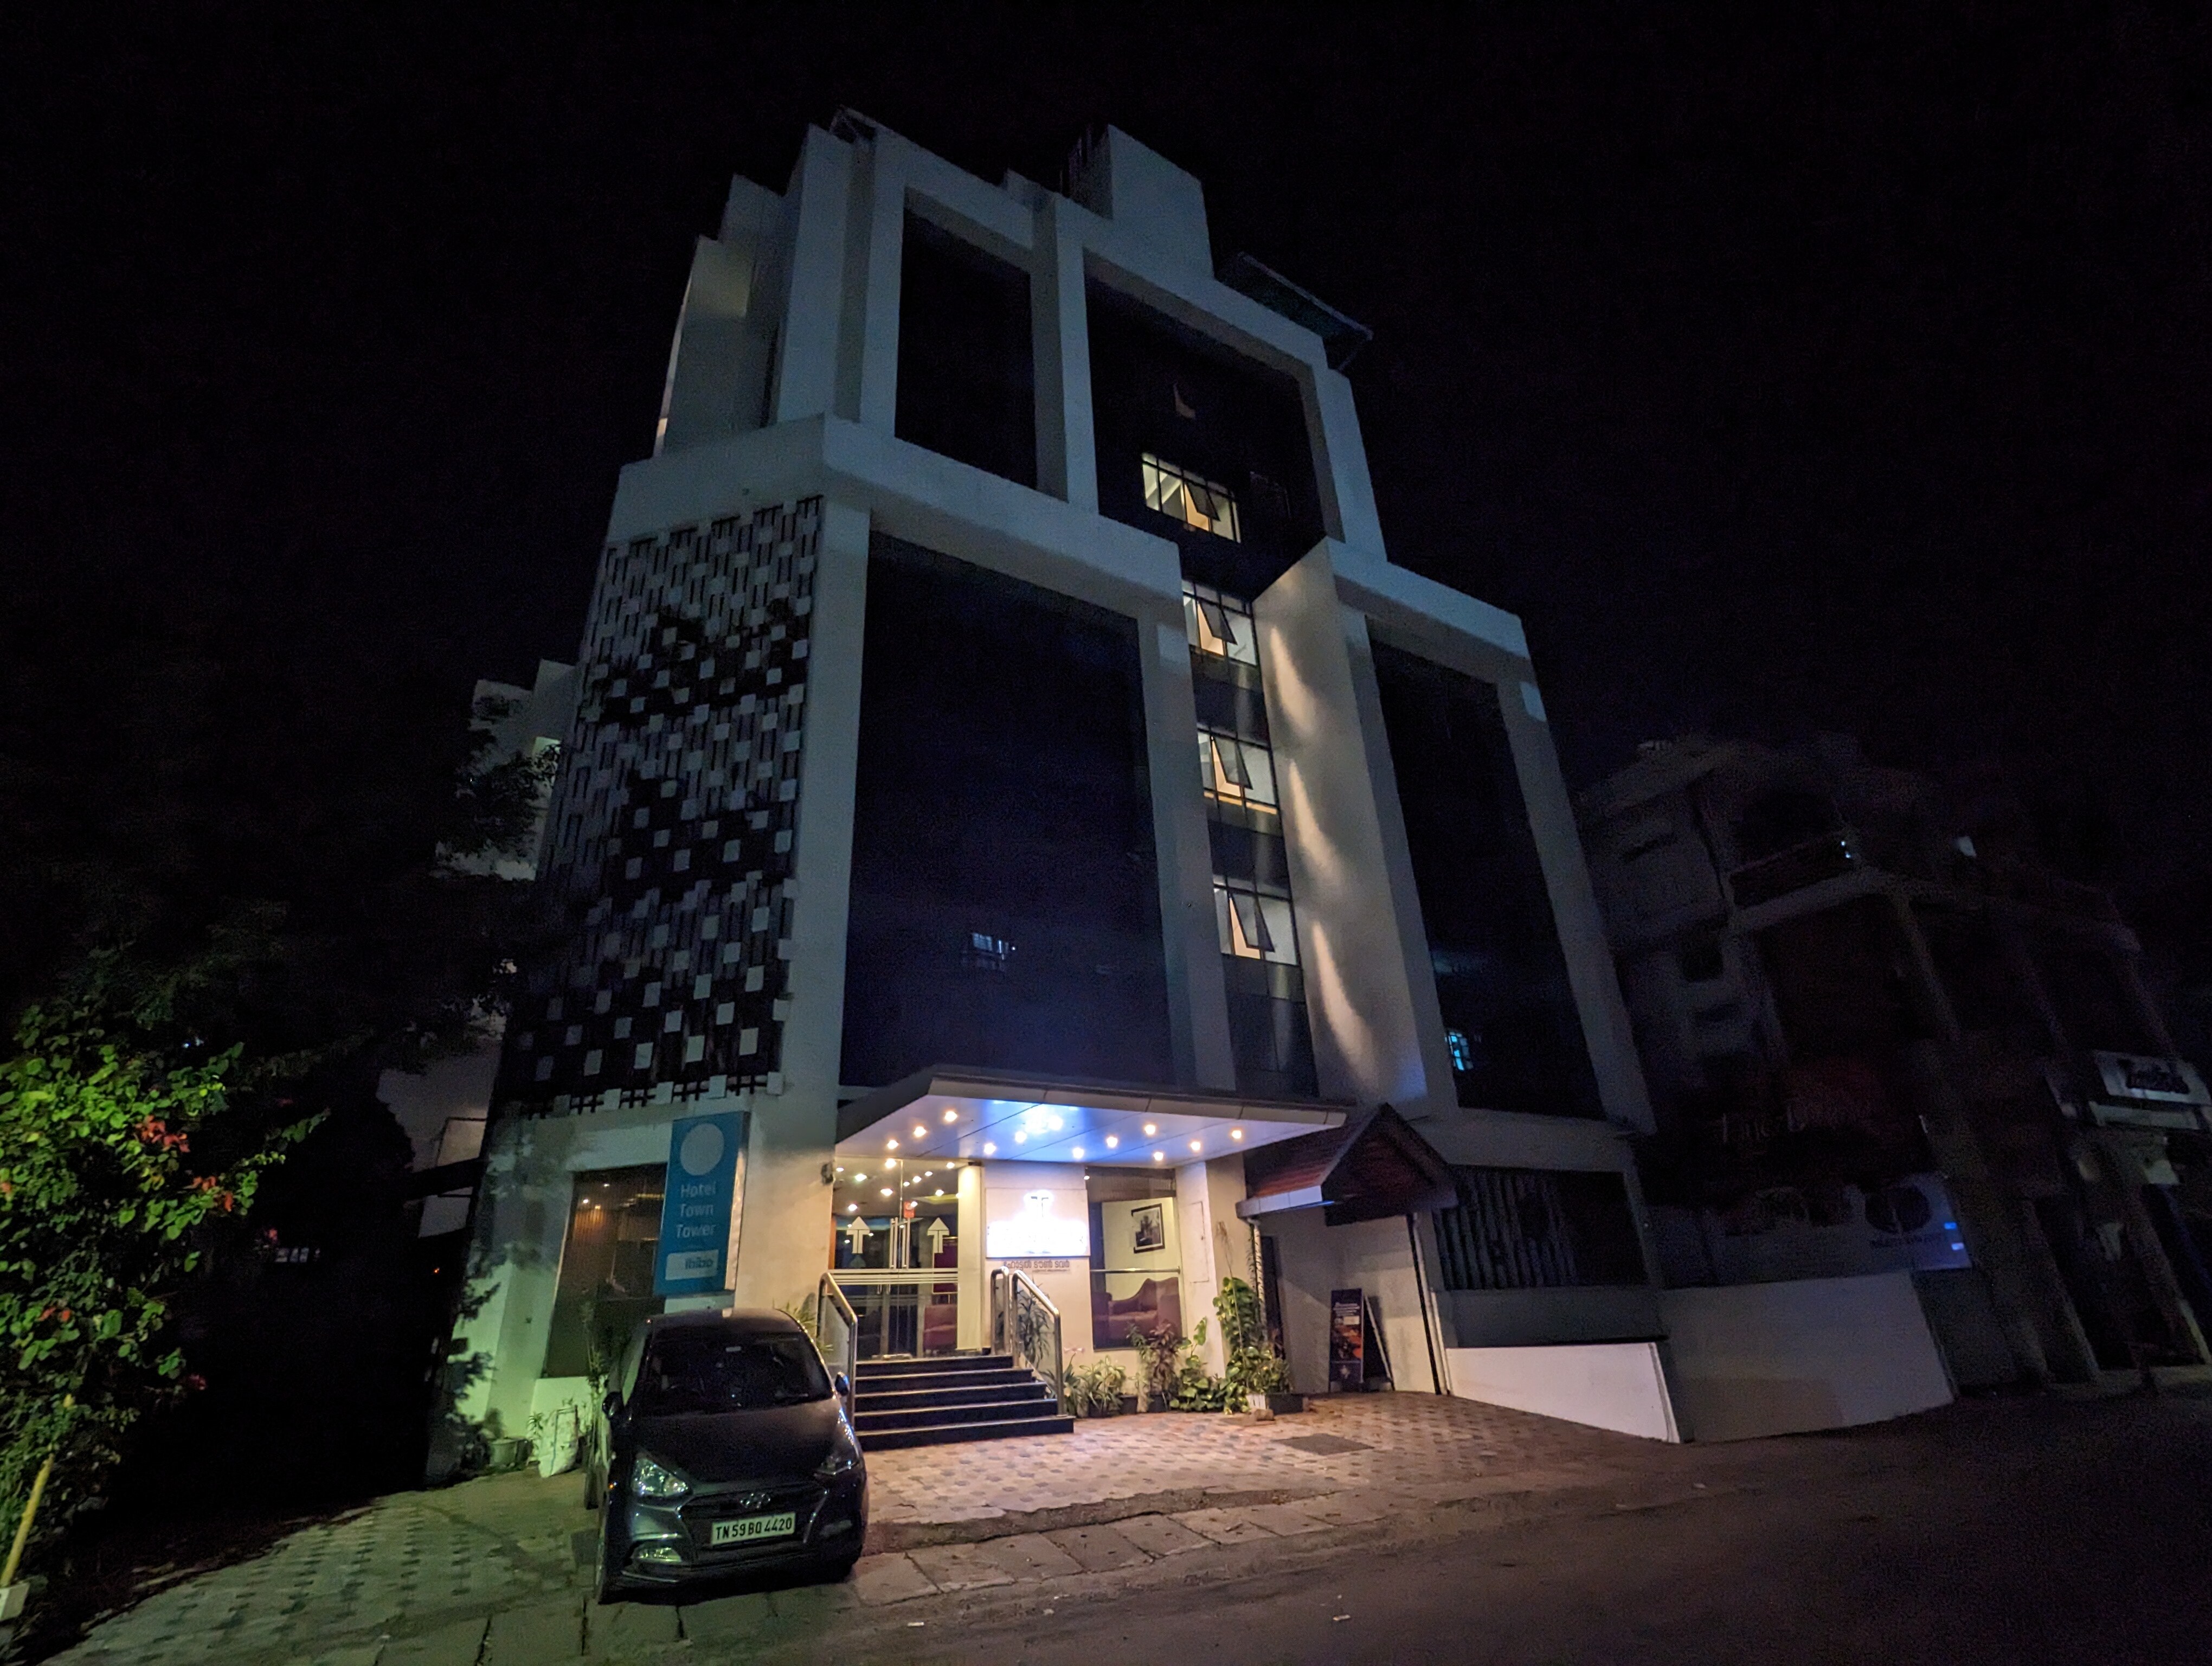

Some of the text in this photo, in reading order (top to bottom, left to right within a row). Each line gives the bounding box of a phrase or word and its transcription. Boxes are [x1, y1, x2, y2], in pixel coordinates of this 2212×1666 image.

[680, 1182, 717, 1198] Hotel
[680, 1203, 714, 1218] Town
[676, 1223, 717, 1239] Tower
